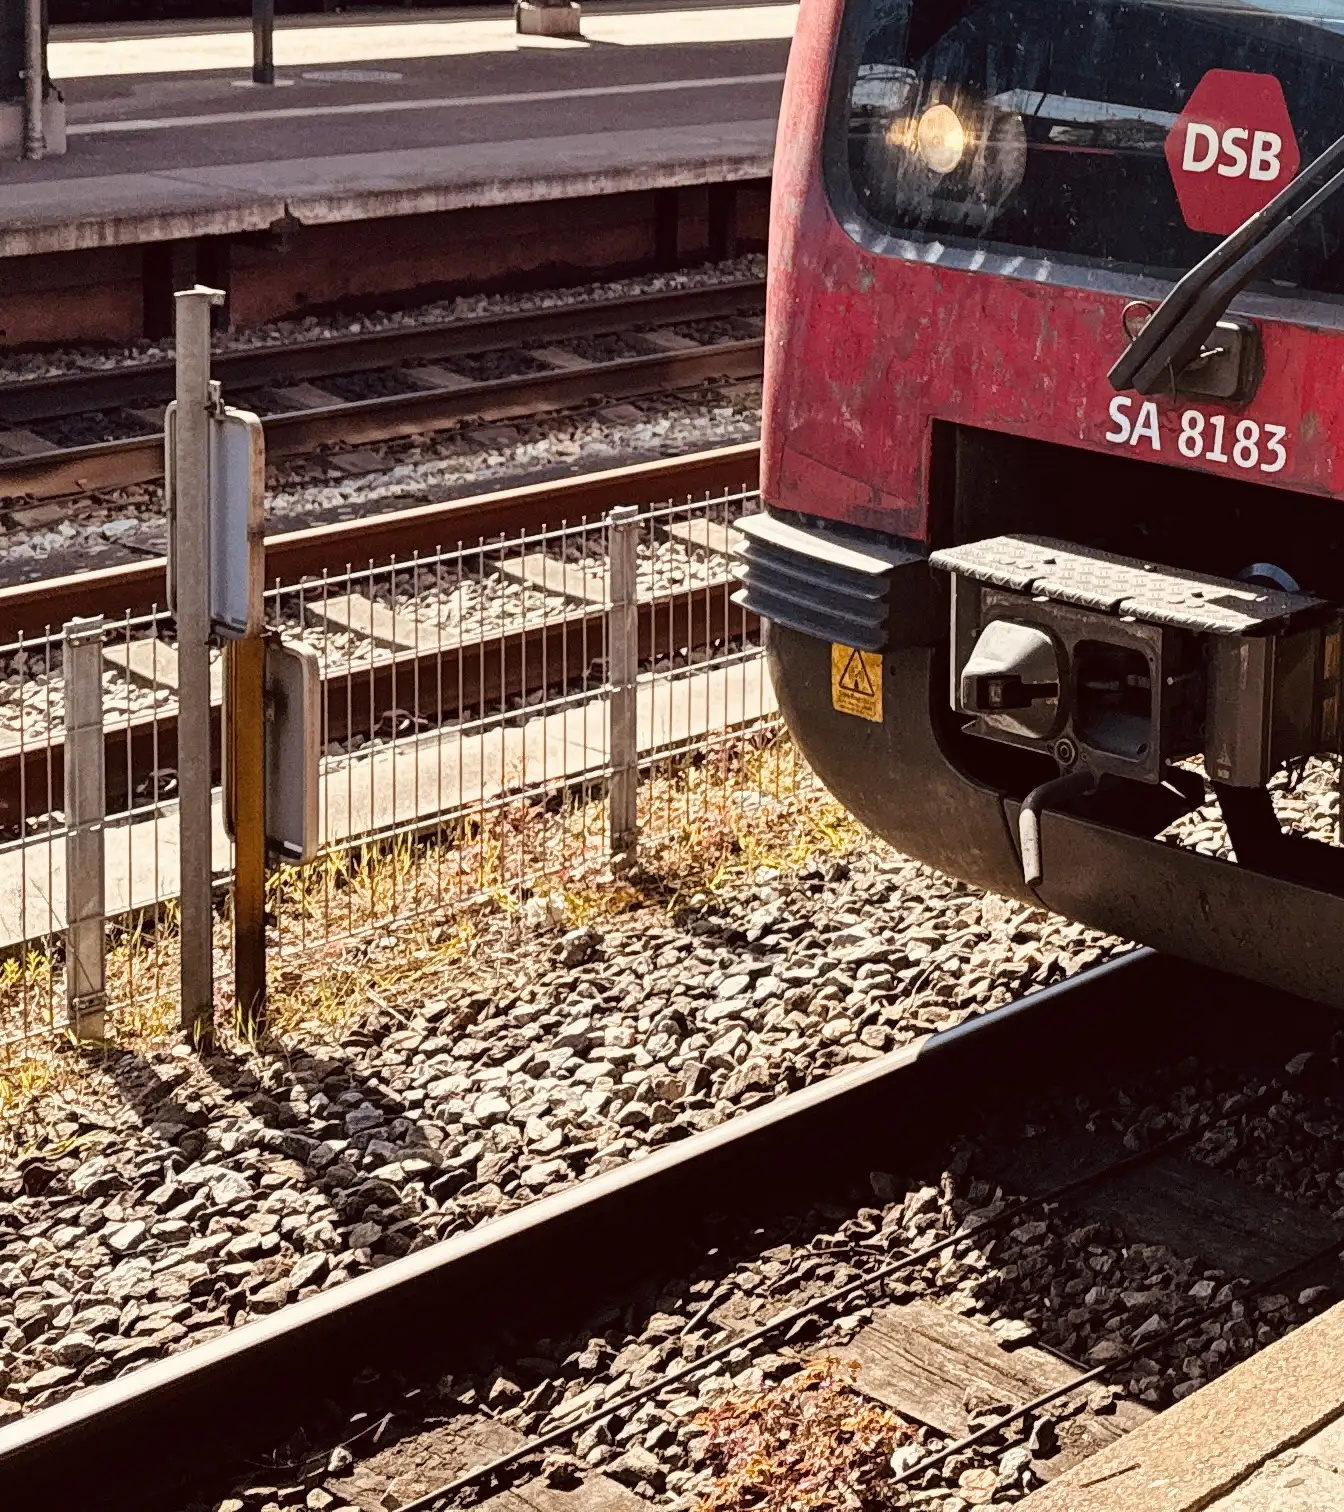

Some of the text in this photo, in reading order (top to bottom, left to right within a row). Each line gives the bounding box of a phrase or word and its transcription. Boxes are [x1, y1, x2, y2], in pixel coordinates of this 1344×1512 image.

[1182, 122, 1282, 181] DSB
[1105, 395, 1288, 473] SA 8183
